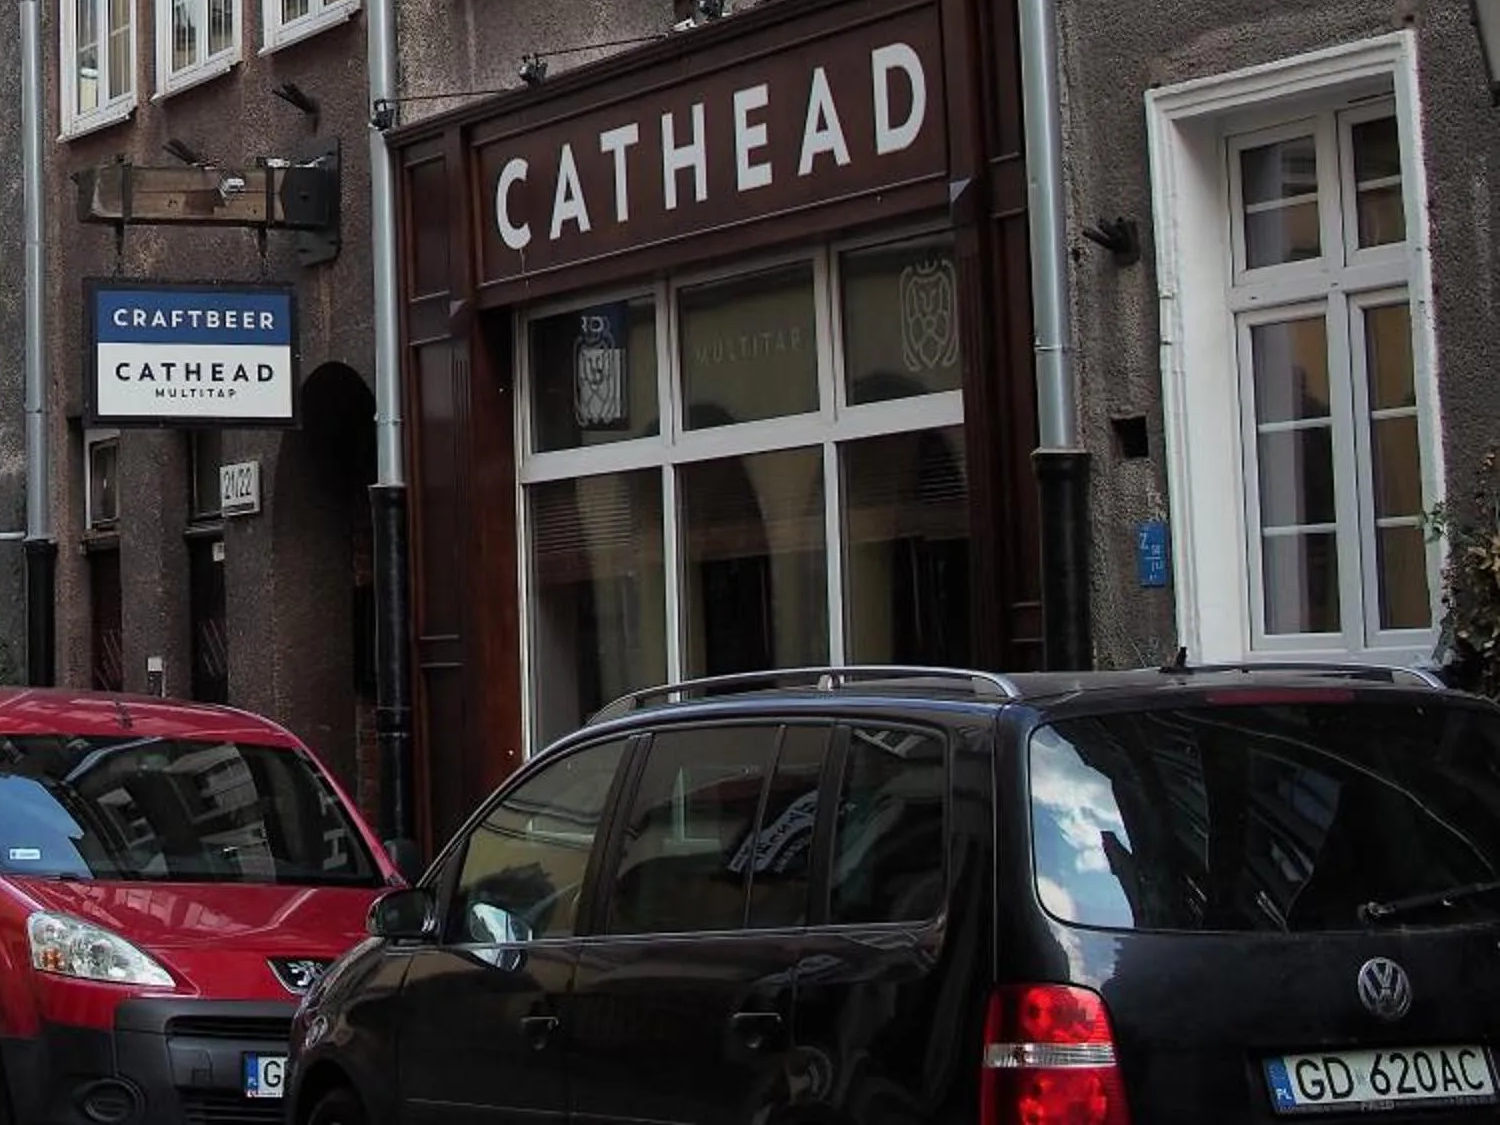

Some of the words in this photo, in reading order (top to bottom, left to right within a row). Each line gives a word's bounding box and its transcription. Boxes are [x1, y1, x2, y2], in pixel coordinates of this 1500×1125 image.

[496, 42, 927, 251] CATHEAD
[113, 308, 274, 330] CRAFTBEER
[115, 362, 274, 382] CATHEAD
[155, 388, 237, 398] MULTITAP
[263, 1060, 281, 1088] G
[1295, 1057, 1355, 1101] GD
[1369, 1049, 1485, 1096] 620AC
